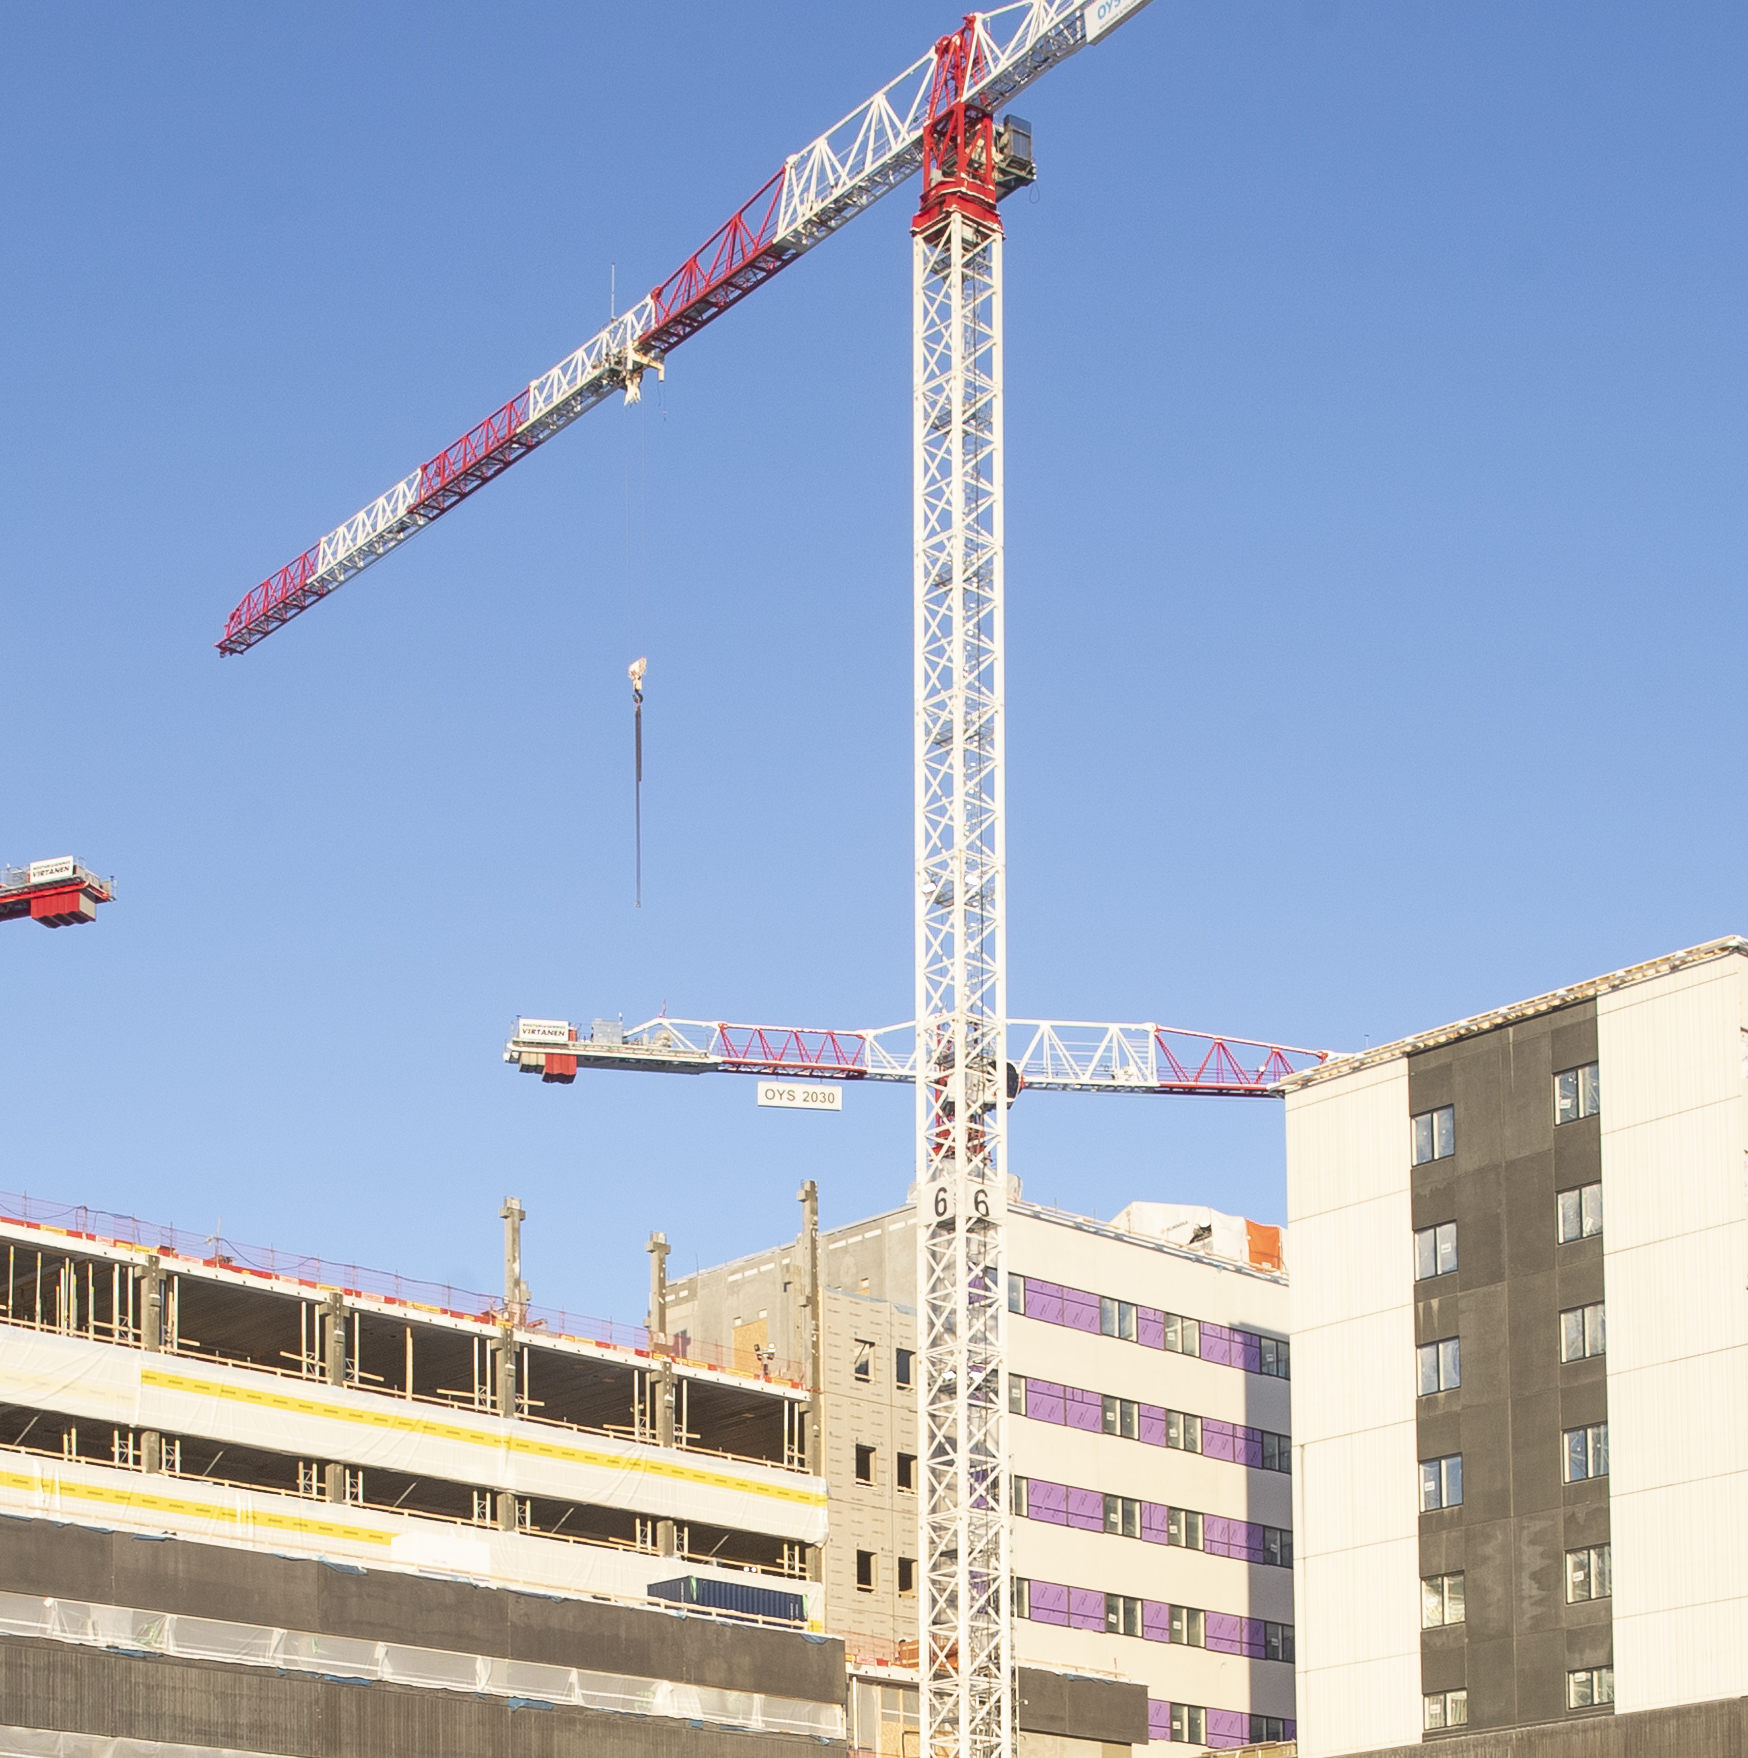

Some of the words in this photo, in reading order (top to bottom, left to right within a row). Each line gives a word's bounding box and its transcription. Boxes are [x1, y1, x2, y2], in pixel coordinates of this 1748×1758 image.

[764, 1088, 796, 1102] OYS
[802, 1090, 835, 1104] 2030
[934, 1186, 948, 1217] 6
[973, 1189, 990, 1217] 6
